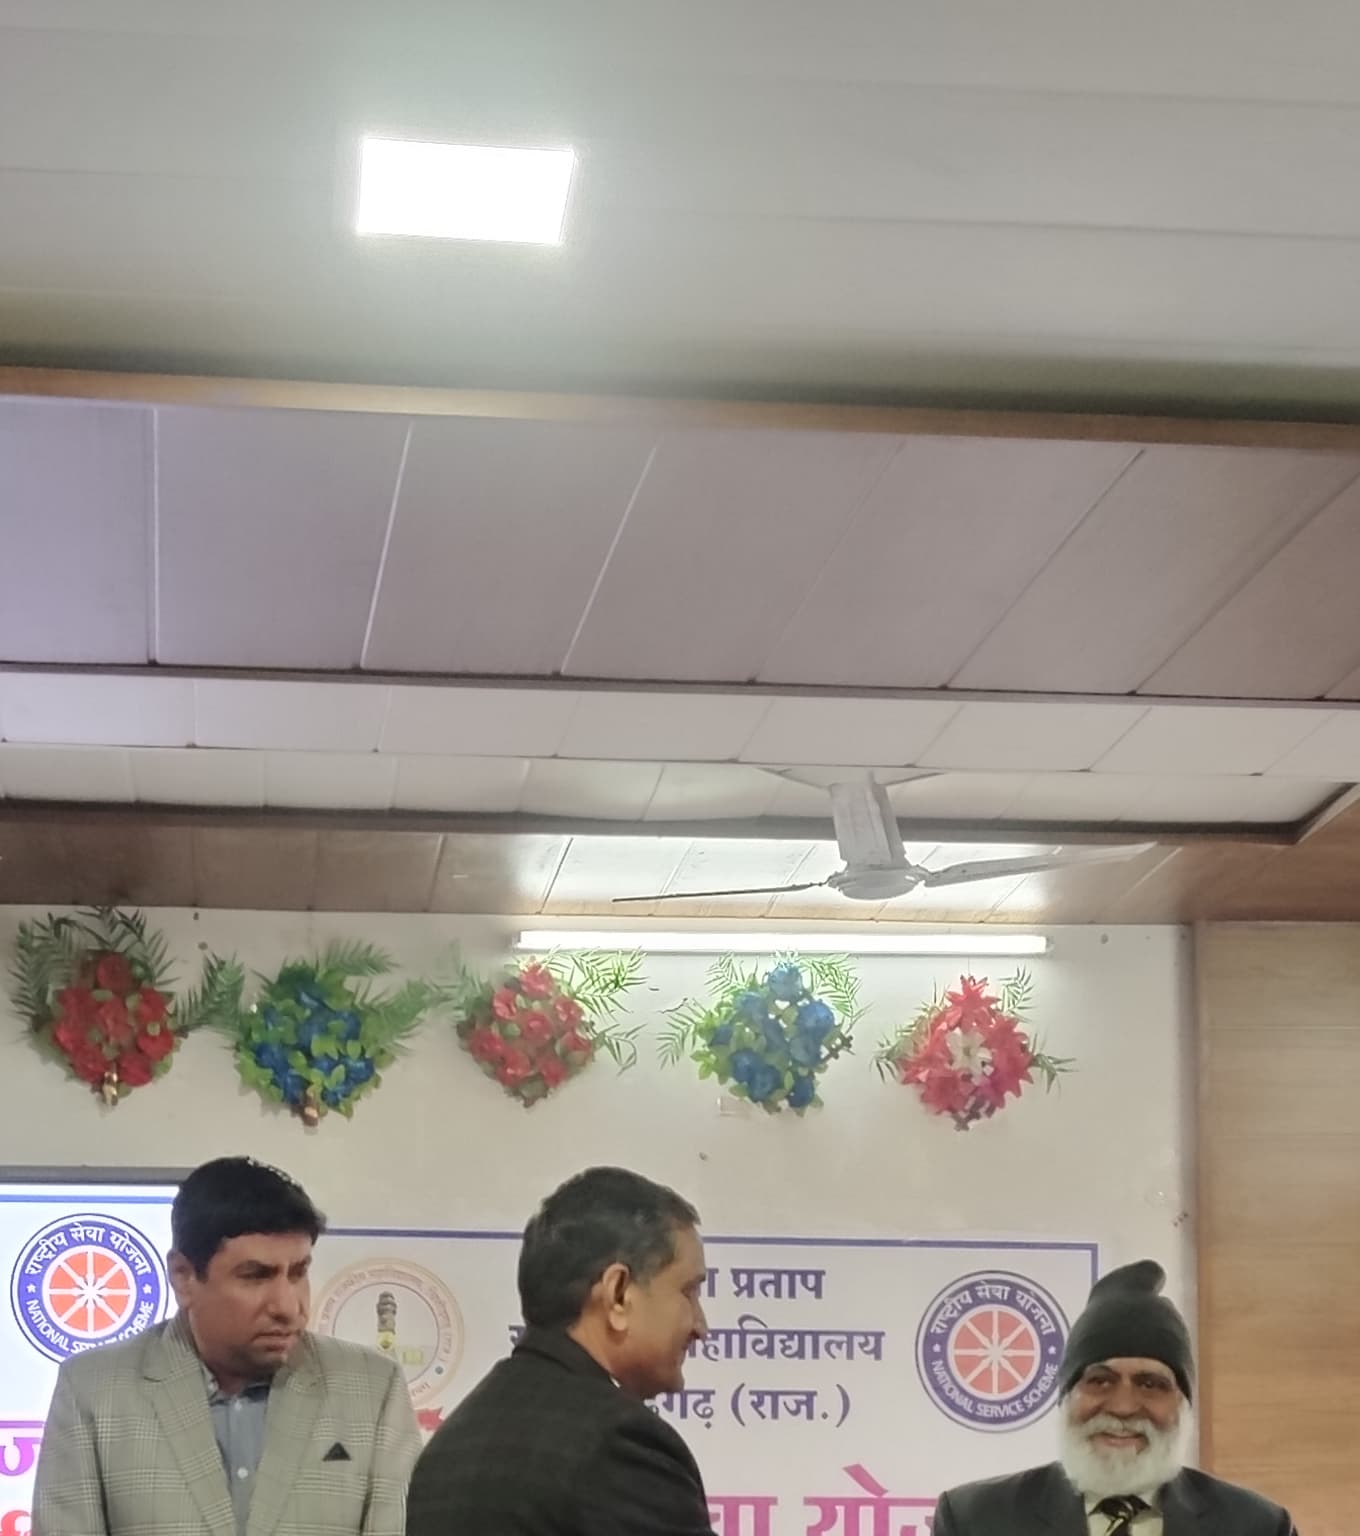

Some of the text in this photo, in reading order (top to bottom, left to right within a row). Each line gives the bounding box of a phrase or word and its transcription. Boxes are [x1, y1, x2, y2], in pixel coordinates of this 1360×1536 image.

[25, 1222, 152, 1276] राष्ट्रीय सेवा योजना
[730, 1268, 826, 1300] प्रताप
[930, 1280, 1057, 1336] राष्ट्रीय सेवा योजना
[26, 1299, 70, 1351] NATIONAL
[687, 1314, 885, 1362] हाविद्यालय
[730, 1382, 851, 1428] (राज.)
[932, 1360, 1059, 1418] NATIONAL SERVICE SCHEME
